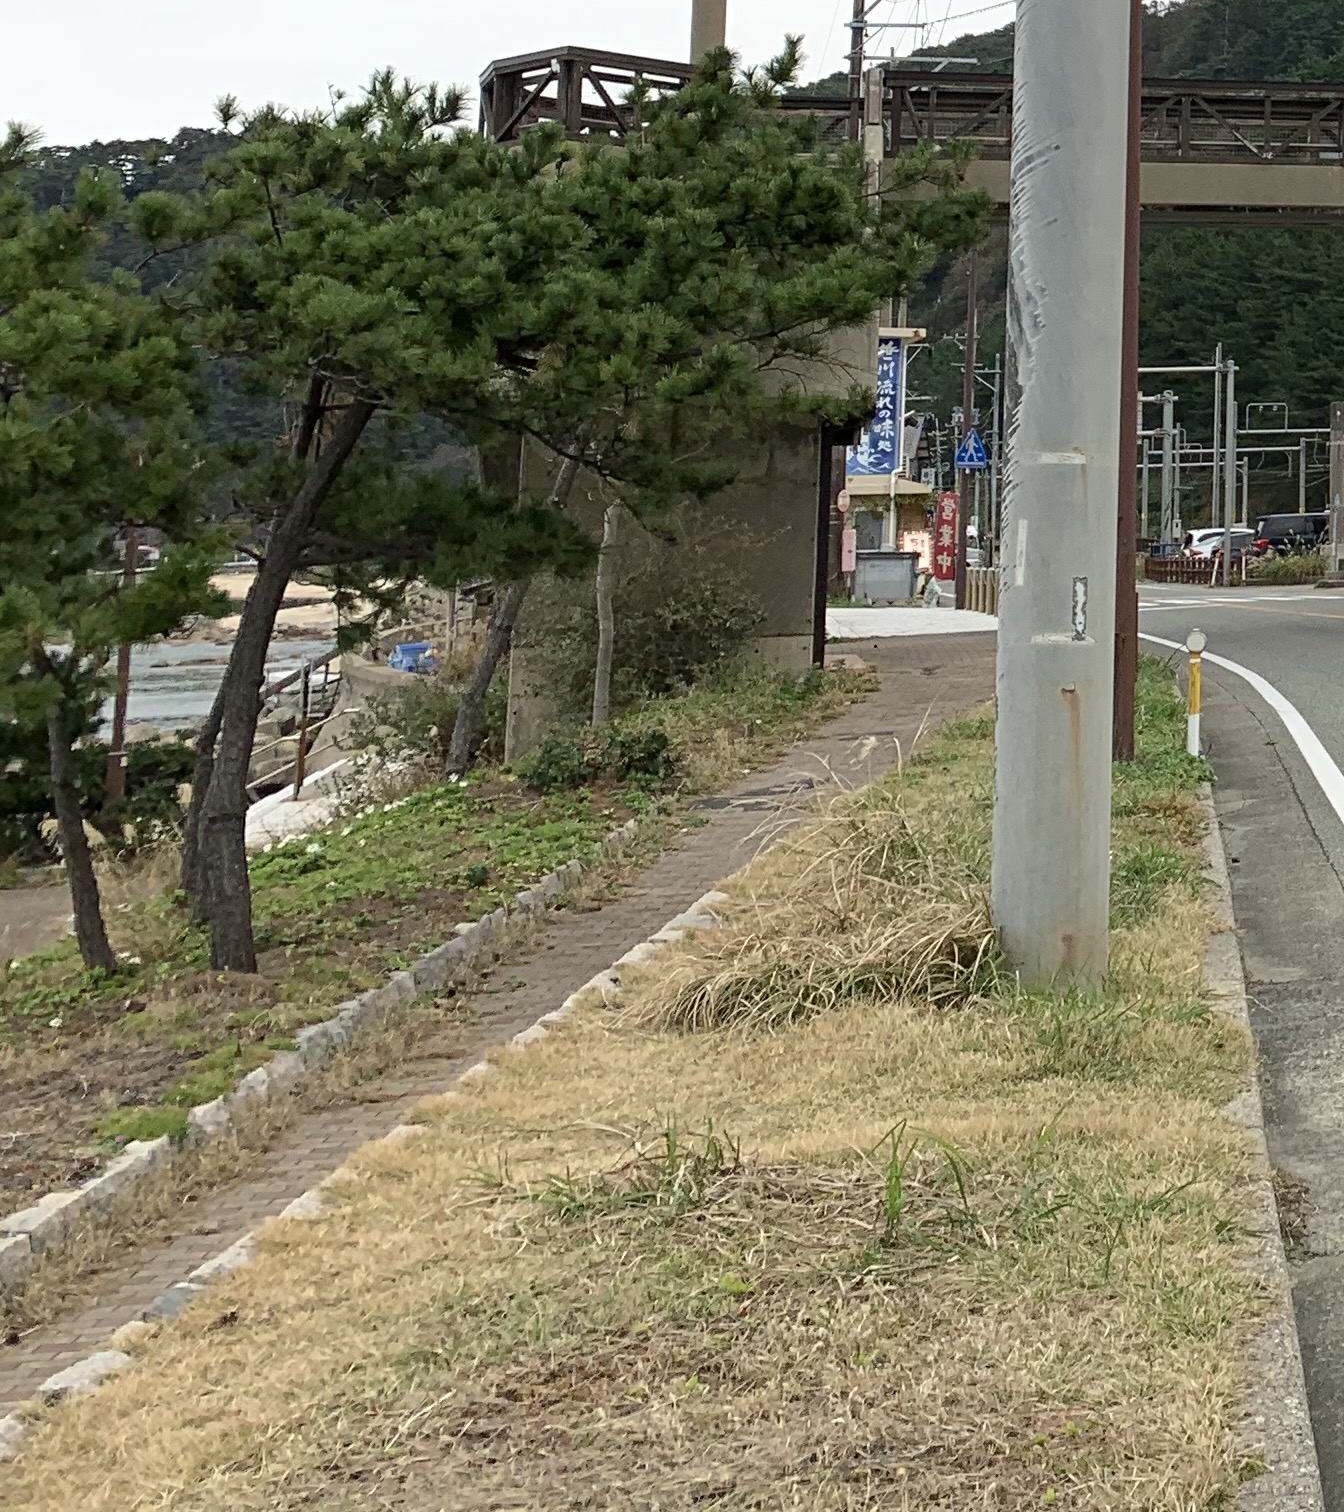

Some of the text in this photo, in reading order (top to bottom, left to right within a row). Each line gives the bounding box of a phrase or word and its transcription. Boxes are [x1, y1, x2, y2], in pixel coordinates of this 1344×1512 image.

[874, 341, 900, 453] 笹川流れの味処
[937, 499, 956, 575] 営業中
